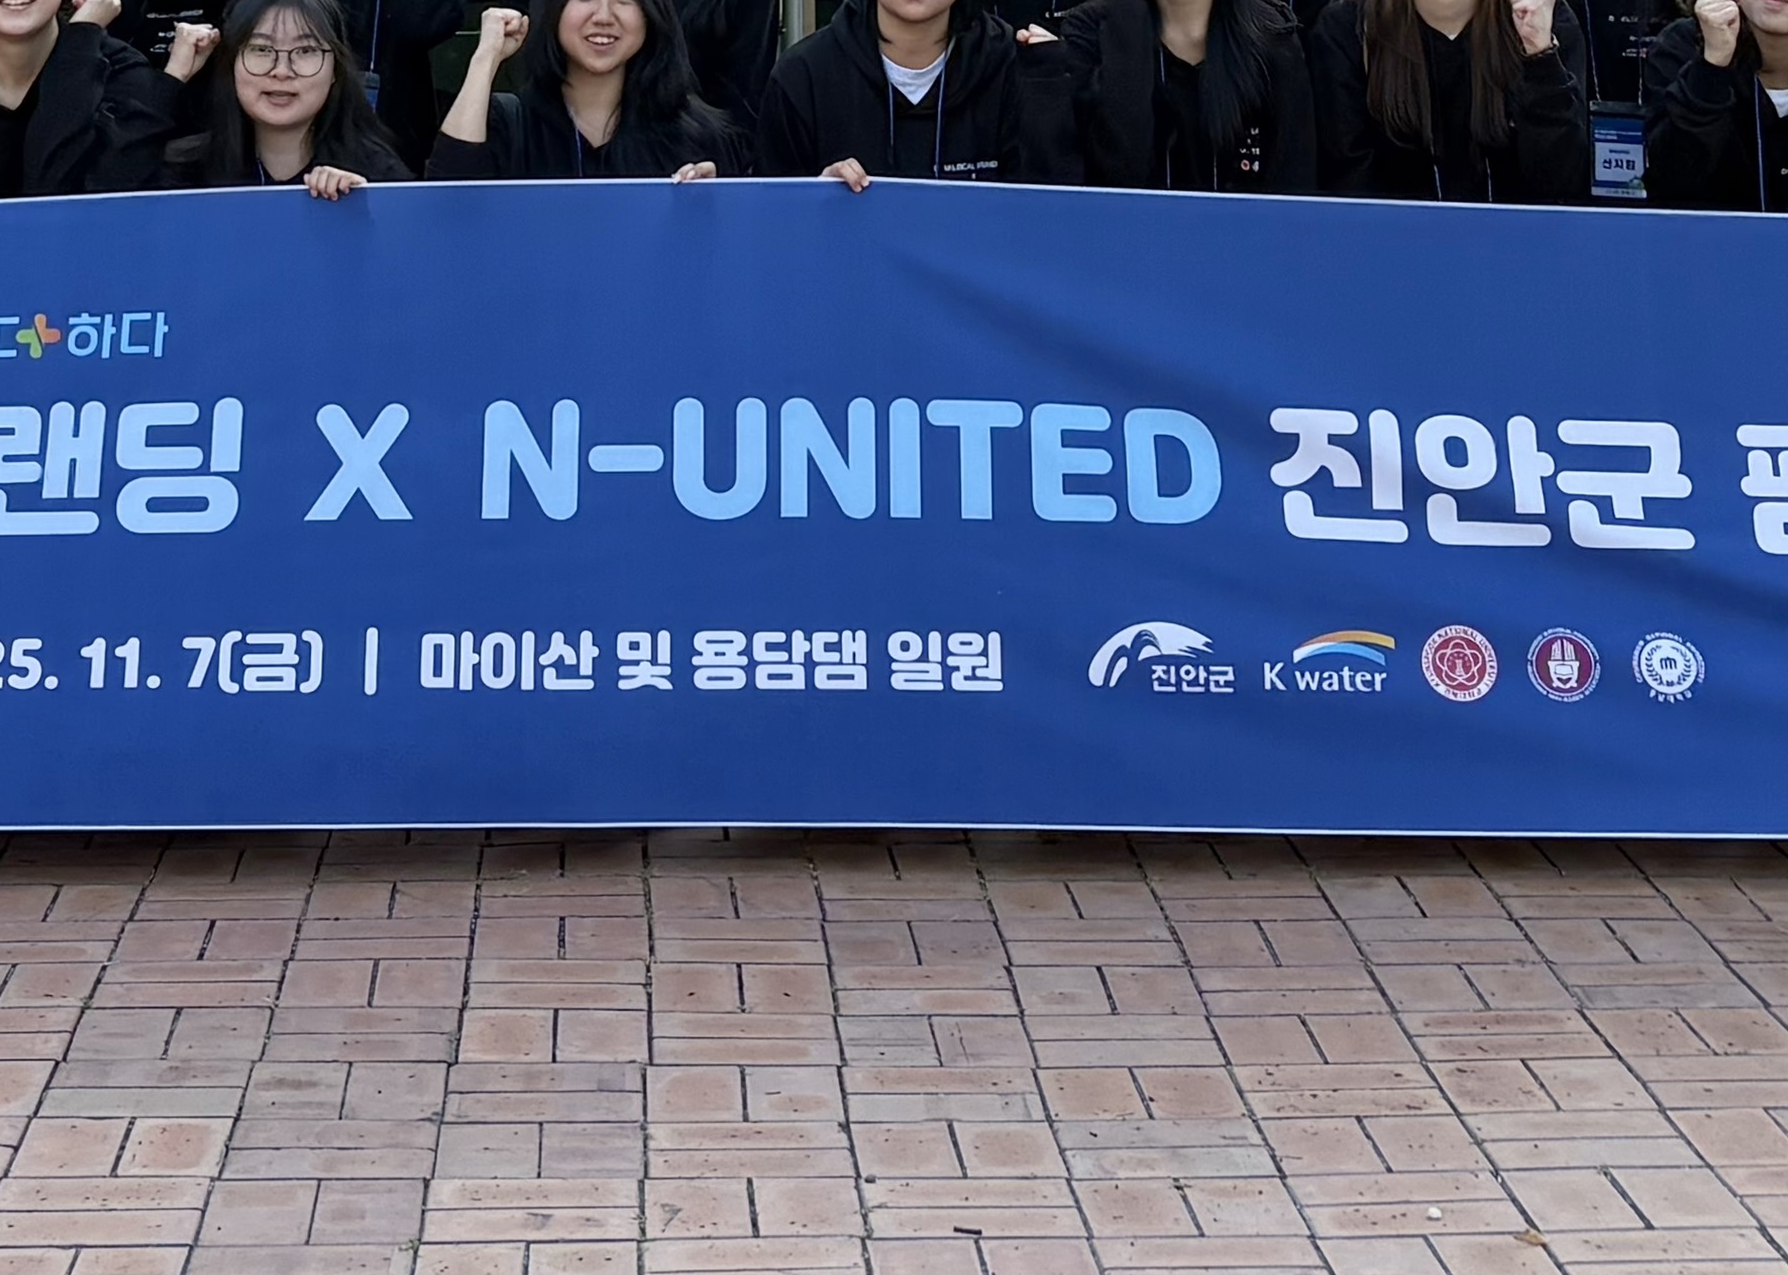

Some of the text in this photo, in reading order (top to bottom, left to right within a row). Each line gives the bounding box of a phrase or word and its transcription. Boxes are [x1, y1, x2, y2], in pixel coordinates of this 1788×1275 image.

[305, 404, 414, 522] X
[482, 398, 1222, 525] N-UNITED
[1270, 408, 1697, 551] 진안군
[81, 638, 162, 690] 11.
[183, 631, 324, 695] 7(금)
[421, 631, 601, 692] 마이산
[617, 631, 674, 691] 및
[692, 630, 868, 691] 용담댐
[888, 632, 1005, 692] 일원
[1150, 664, 1236, 694] 진안군
[1264, 663, 1387, 692] K water
